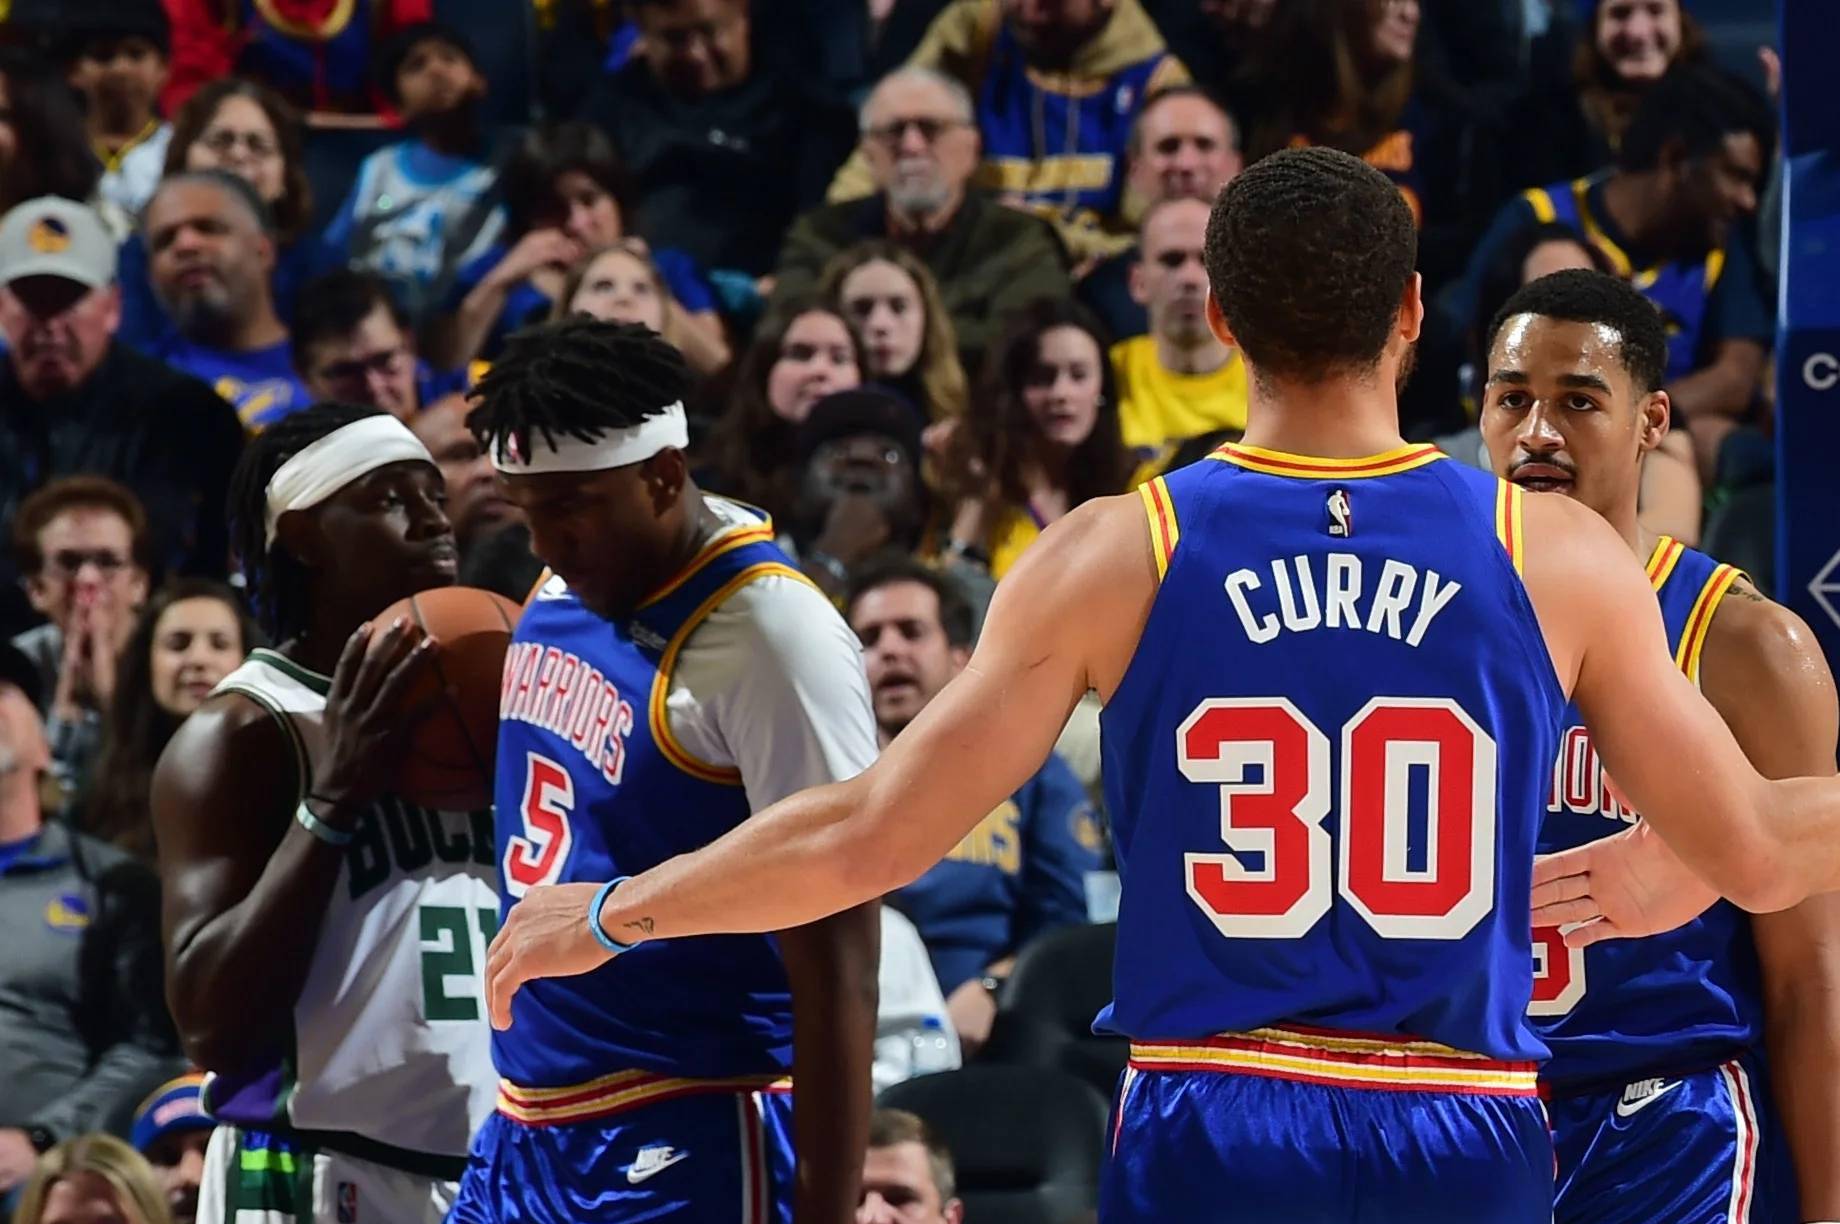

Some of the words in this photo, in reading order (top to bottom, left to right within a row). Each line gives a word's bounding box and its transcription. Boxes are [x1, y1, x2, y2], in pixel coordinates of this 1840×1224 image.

[1225, 553, 1461, 647] CURRY
[500, 642, 633, 786] WARRIORS
[503, 752, 574, 899] 5
[1176, 696, 1497, 940] 30
[1624, 1077, 1665, 1102] NIKE
